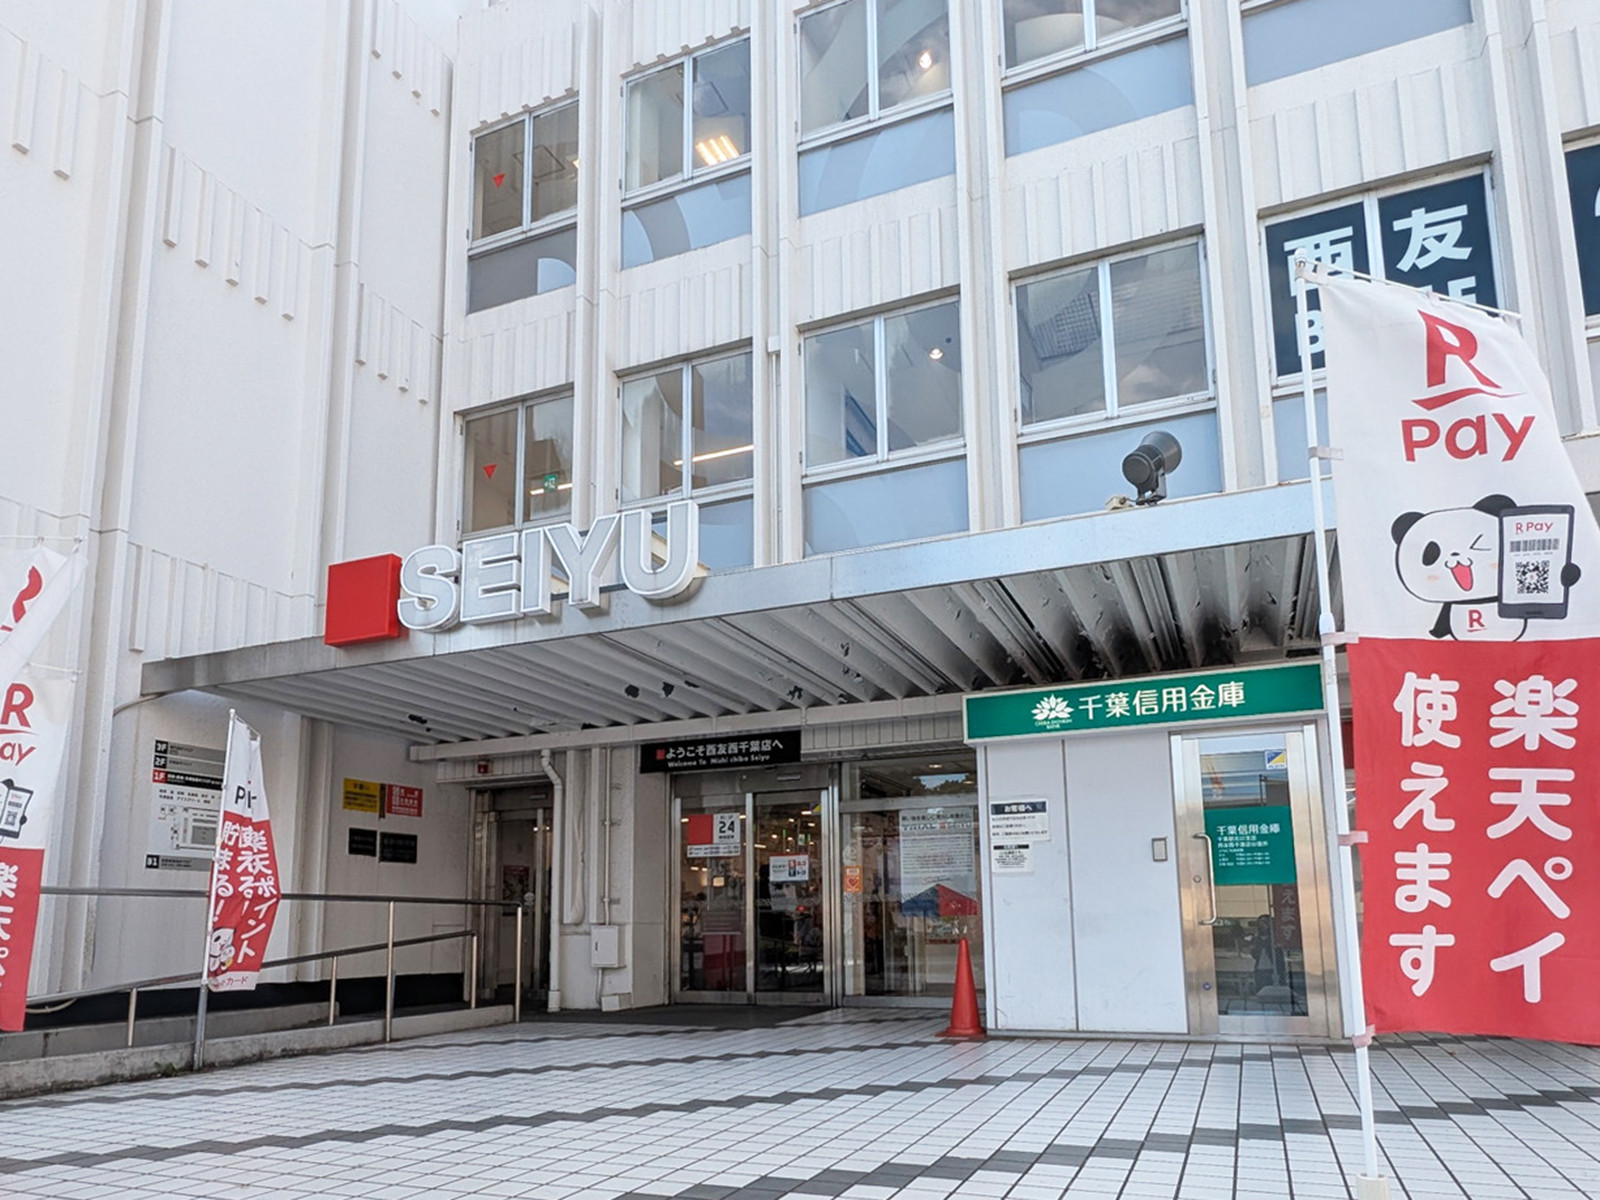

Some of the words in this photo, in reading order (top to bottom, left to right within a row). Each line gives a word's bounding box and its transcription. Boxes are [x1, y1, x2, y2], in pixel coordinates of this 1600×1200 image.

[1417, 308, 1503, 389] R
[397, 499, 700, 633] SEIYU
[1078, 681, 1247, 720] 千葉信用金庫
[665, 739, 784, 760] ようこそ西友西千葉店へ
[718, 820, 735, 834] 24
[1216, 822, 1281, 835] 千葉信用金庫
[1389, 671, 1461, 997] 使えます
[1486, 674, 1579, 1004] 楽天ペイ
